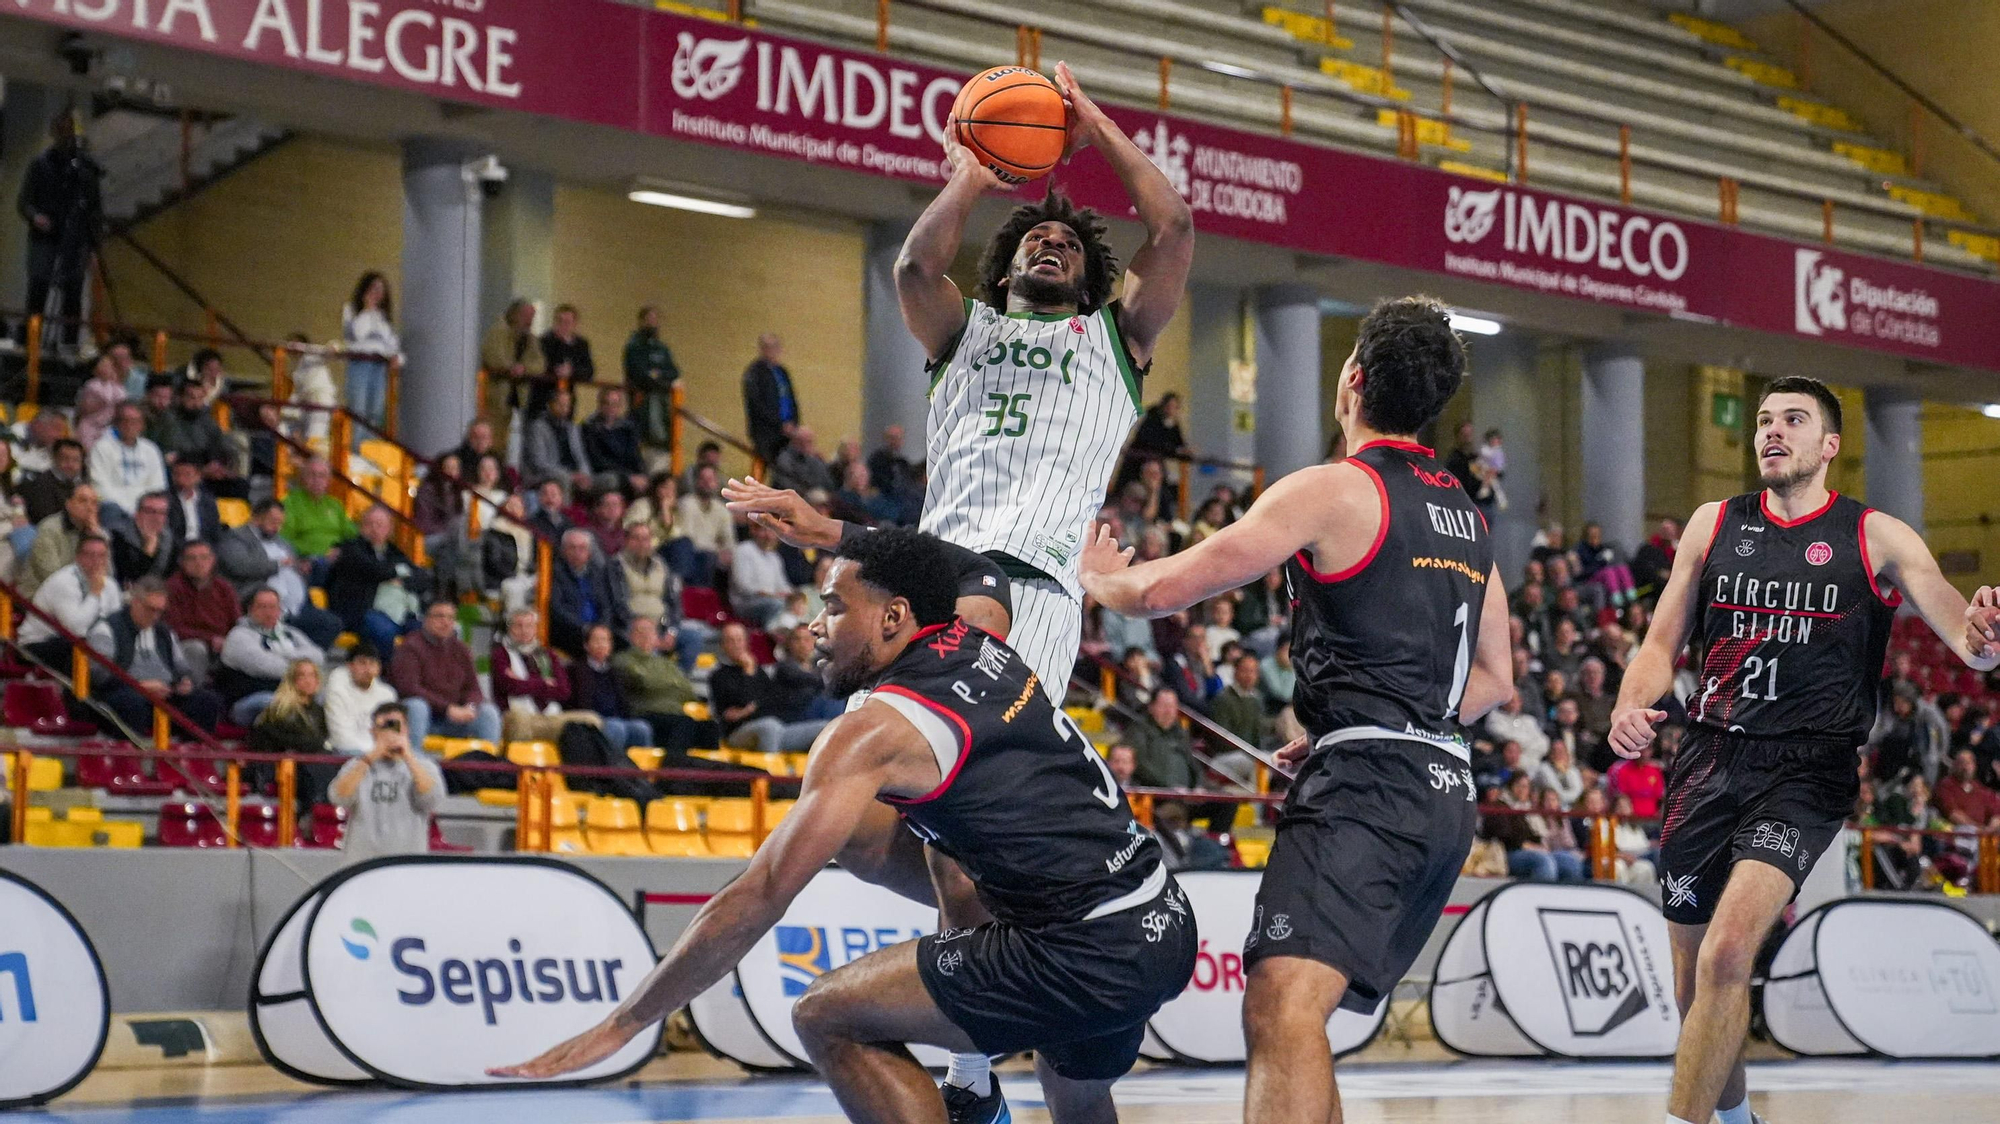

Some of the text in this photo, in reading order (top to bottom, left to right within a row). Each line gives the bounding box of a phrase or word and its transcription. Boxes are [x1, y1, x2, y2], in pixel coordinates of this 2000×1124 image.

[242, 0, 522, 98] ALEGRE
[756, 41, 962, 146] IMDEC
[672, 108, 747, 144] Instituto
[749, 123, 836, 162] Municipal
[836, 142, 862, 165] de
[862, 143, 940, 179] Deportes
[1504, 191, 1689, 281] IMDECO
[981, 392, 1032, 438] 35
[1426, 502, 1475, 542] REILLY
[1716, 572, 1838, 613] CÍRCULO
[1732, 610, 1813, 645] GIJÓN
[951, 680, 986, 704] P.
[1446, 602, 1469, 720] 1
[1741, 655, 1779, 701] 21
[1053, 709, 1119, 810] 3
[391, 937, 622, 1025] Sepisur
[1562, 942, 1629, 999] RG3
